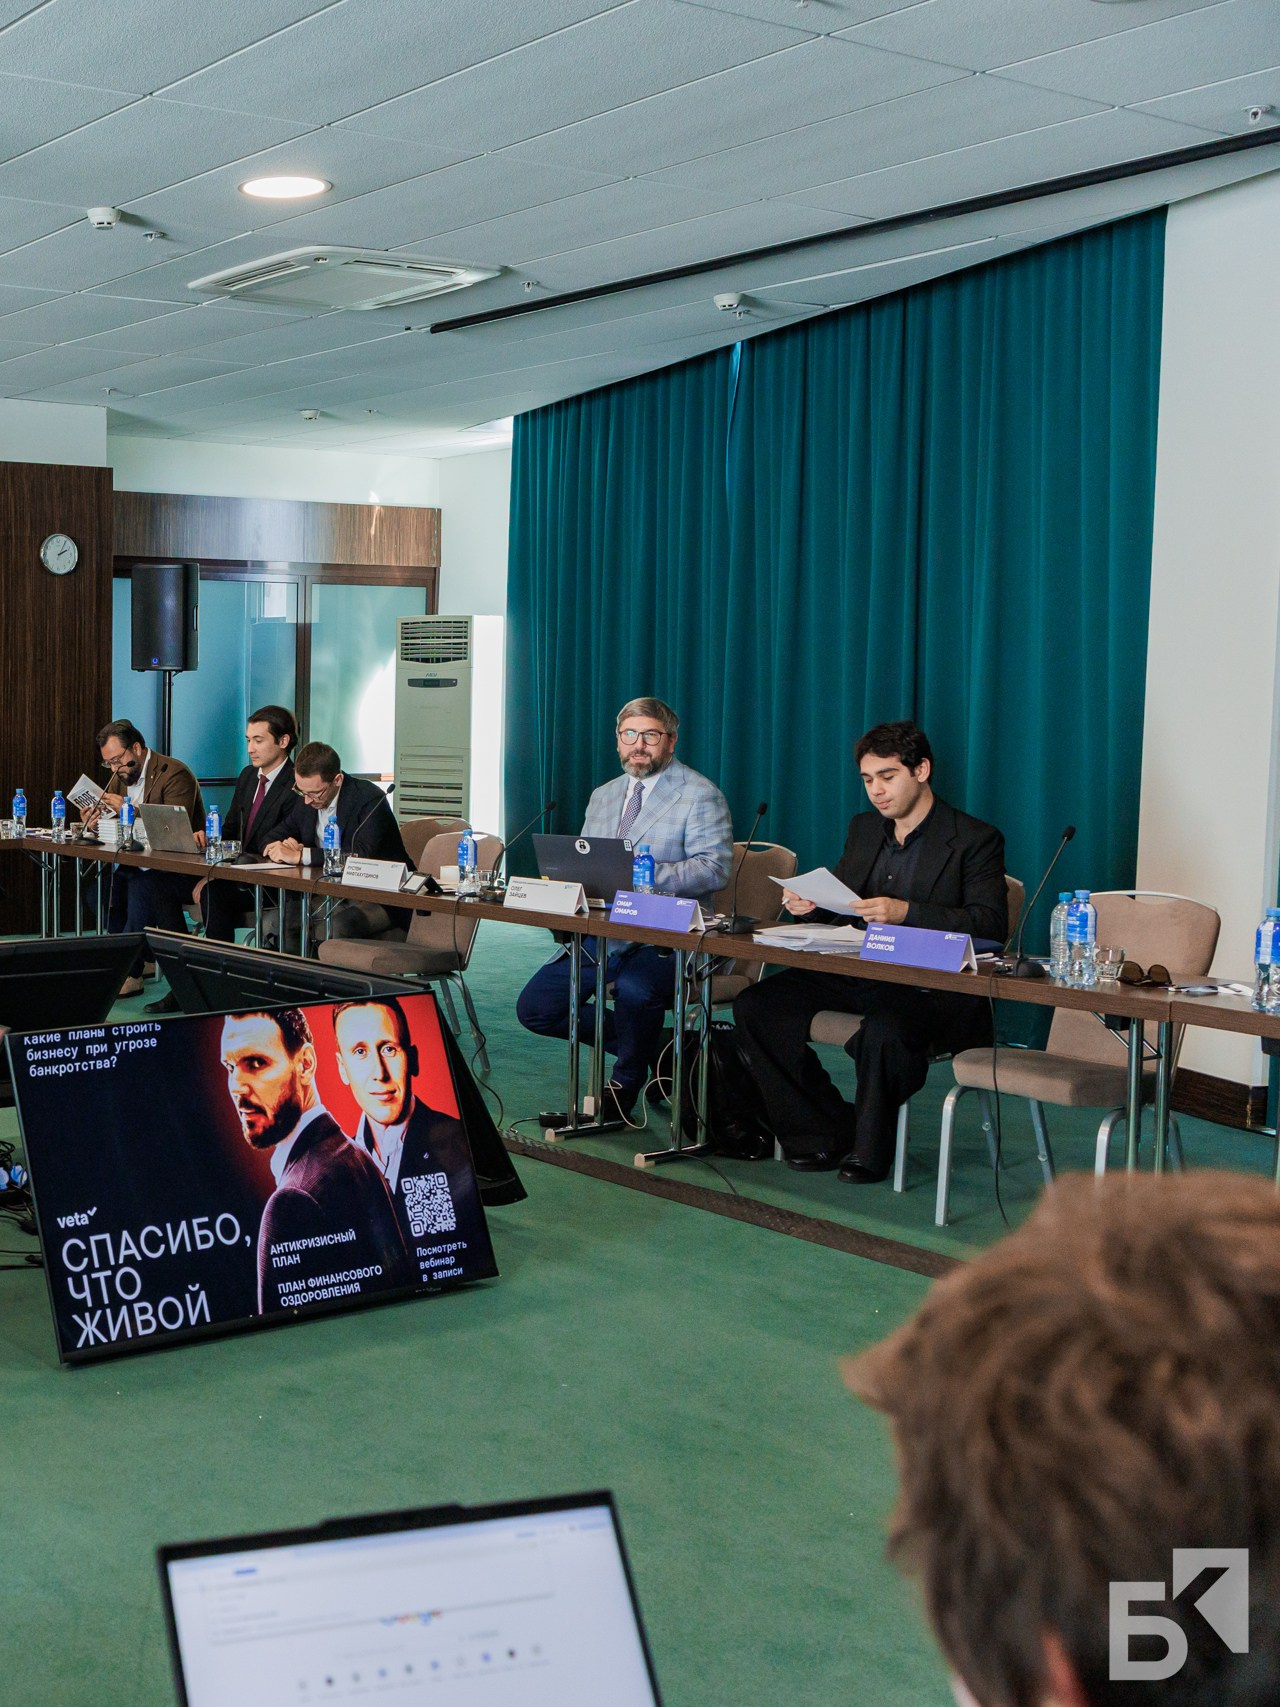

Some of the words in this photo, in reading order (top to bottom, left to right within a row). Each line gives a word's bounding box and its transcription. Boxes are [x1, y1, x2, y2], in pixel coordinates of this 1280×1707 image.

[68, 1028, 106, 1041] планы
[111, 1022, 162, 1037] строить
[26, 1046, 79, 1062] бизнесу
[85, 1043, 109, 1057] при
[114, 1037, 158, 1054] угрозе
[29, 1055, 118, 1078] банкротства?
[57, 1211, 89, 1229] veta
[62, 1212, 251, 1272] СПАСИБО,
[270, 1228, 356, 1256] АНТИКРИЗИСНЫЙ
[416, 1240, 468, 1258] Посмотреть
[272, 1253, 301, 1269] ПЛАН
[419, 1255, 456, 1271] вебинар
[277, 1280, 306, 1295] ПЛАН
[307, 1264, 383, 1289] ФИНАНСОВОГО
[422, 1273, 429, 1283] в
[432, 1266, 464, 1281] записи
[67, 1266, 142, 1308] ЧТО
[280, 1282, 361, 1308] ОЗДОРОВЛЕНИЯ
[72, 1283, 211, 1349] ЖИВОЙ
